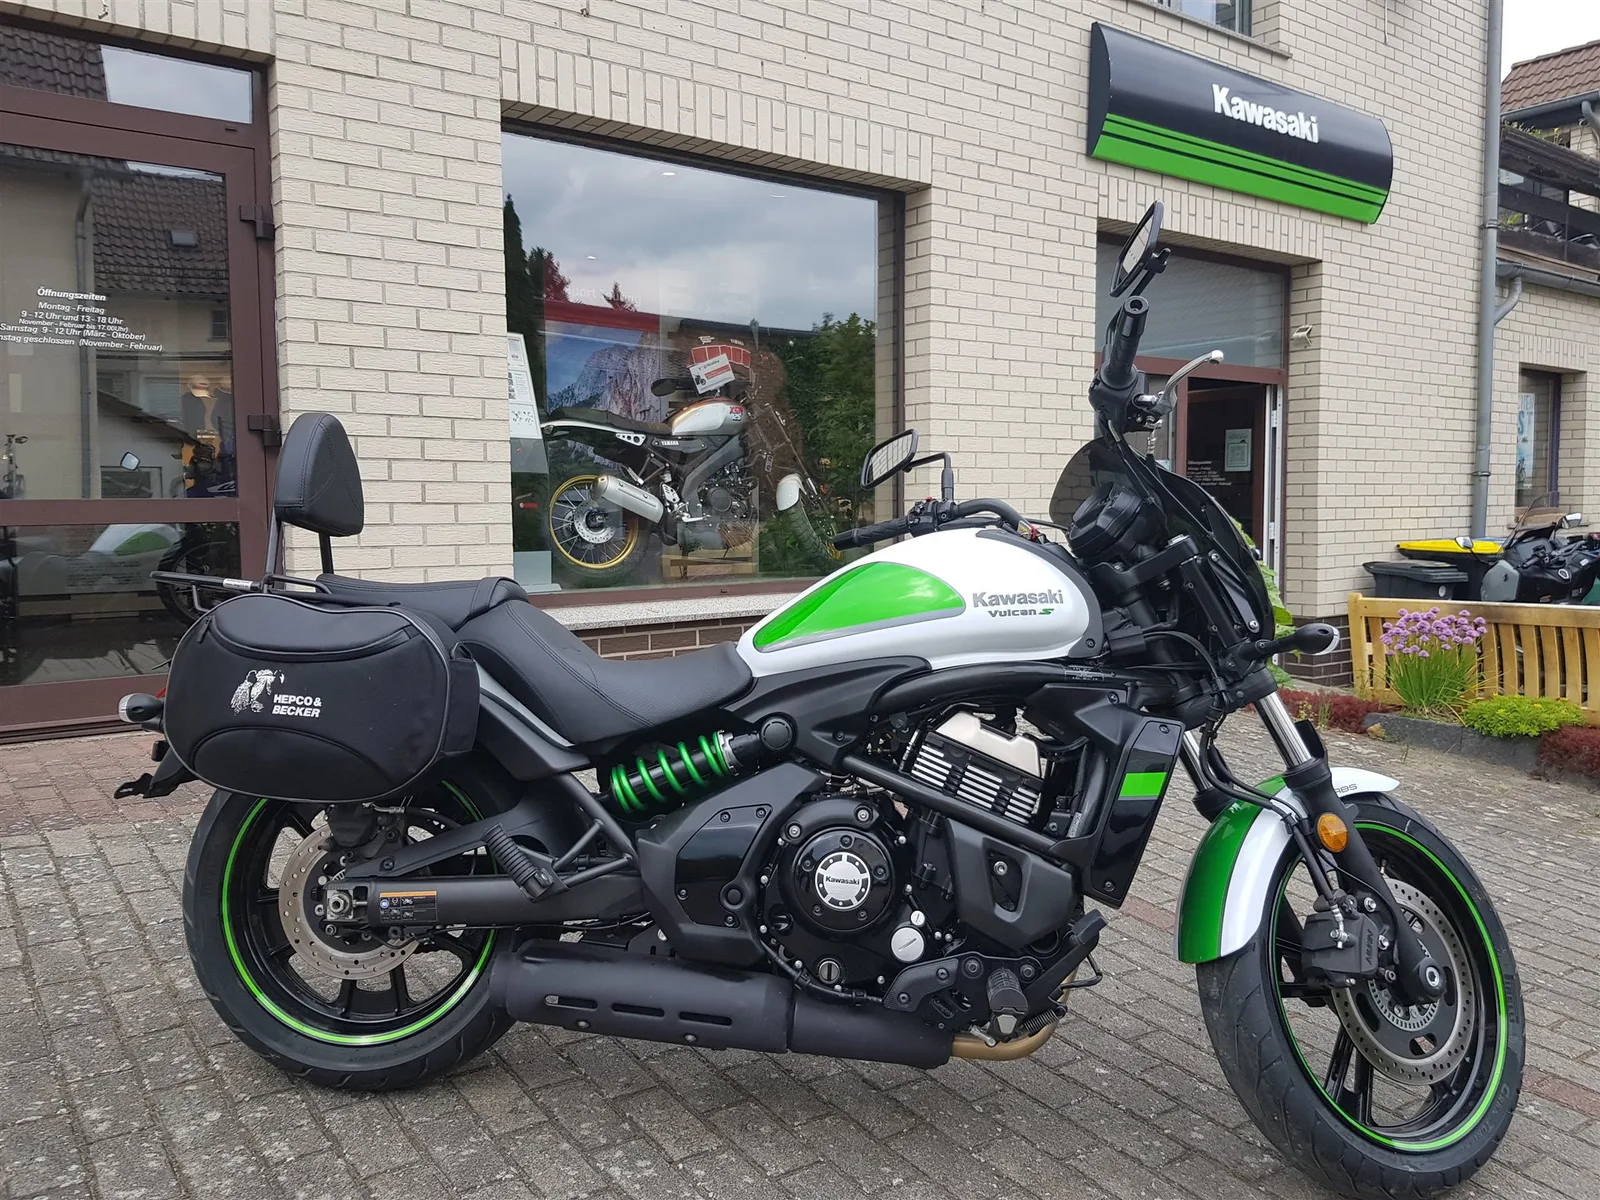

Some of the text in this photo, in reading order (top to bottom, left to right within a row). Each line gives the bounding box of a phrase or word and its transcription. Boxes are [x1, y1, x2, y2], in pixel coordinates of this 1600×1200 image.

[1212, 83, 1319, 143] Kawasaki
[37, 286, 106, 301] Öffnungszeiten
[38, 302, 71, 312] Montag
[77, 305, 105, 315] Freitag
[19, 319, 54, 327] November
[59, 321, 85, 329] Februar
[45, 312, 61, 320] Uhr
[108, 317, 123, 325] Uhr
[0, 323, 38, 334] Samstag
[65, 328, 82, 336] Uhr
[83, 329, 106, 337] (März
[111, 331, 146, 341] Oktober)
[23, 336, 75, 345] geschlossen
[79, 338, 124, 348] (November
[129, 341, 163, 352] Februar)
[972, 589, 1064, 608] Kawasaki
[987, 608, 1037, 618] Vulcan
[273, 694, 322, 707] HEPCO &
[272, 704, 321, 718] BECKER
[825, 875, 860, 885] Kawasaki
